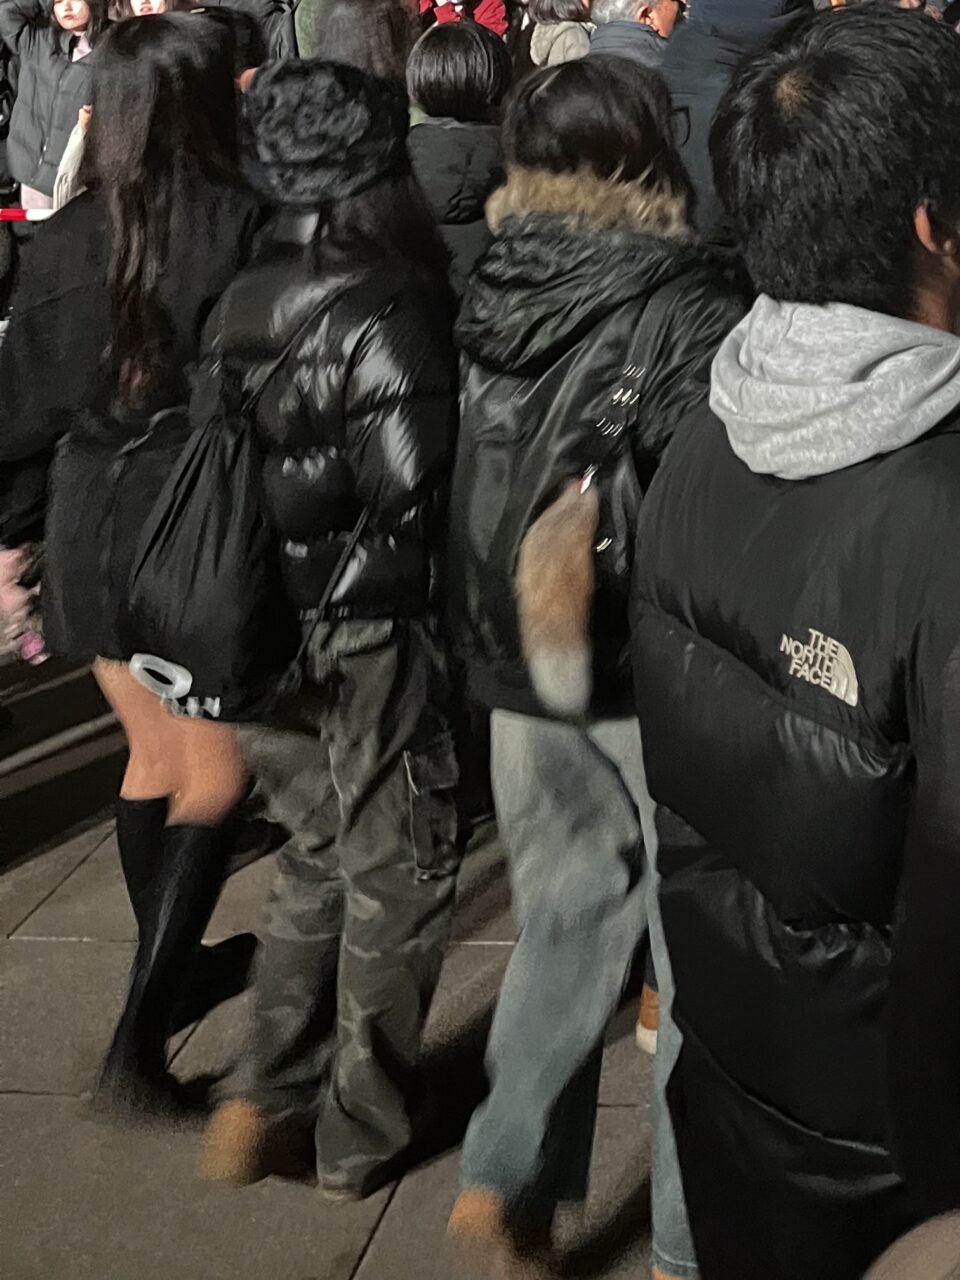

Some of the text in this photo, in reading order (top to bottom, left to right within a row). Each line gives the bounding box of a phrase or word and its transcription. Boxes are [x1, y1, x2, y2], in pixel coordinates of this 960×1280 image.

[780, 633, 834, 675] NORTH
[808, 628, 840, 658] THE
[789, 658, 833, 689] FACE
